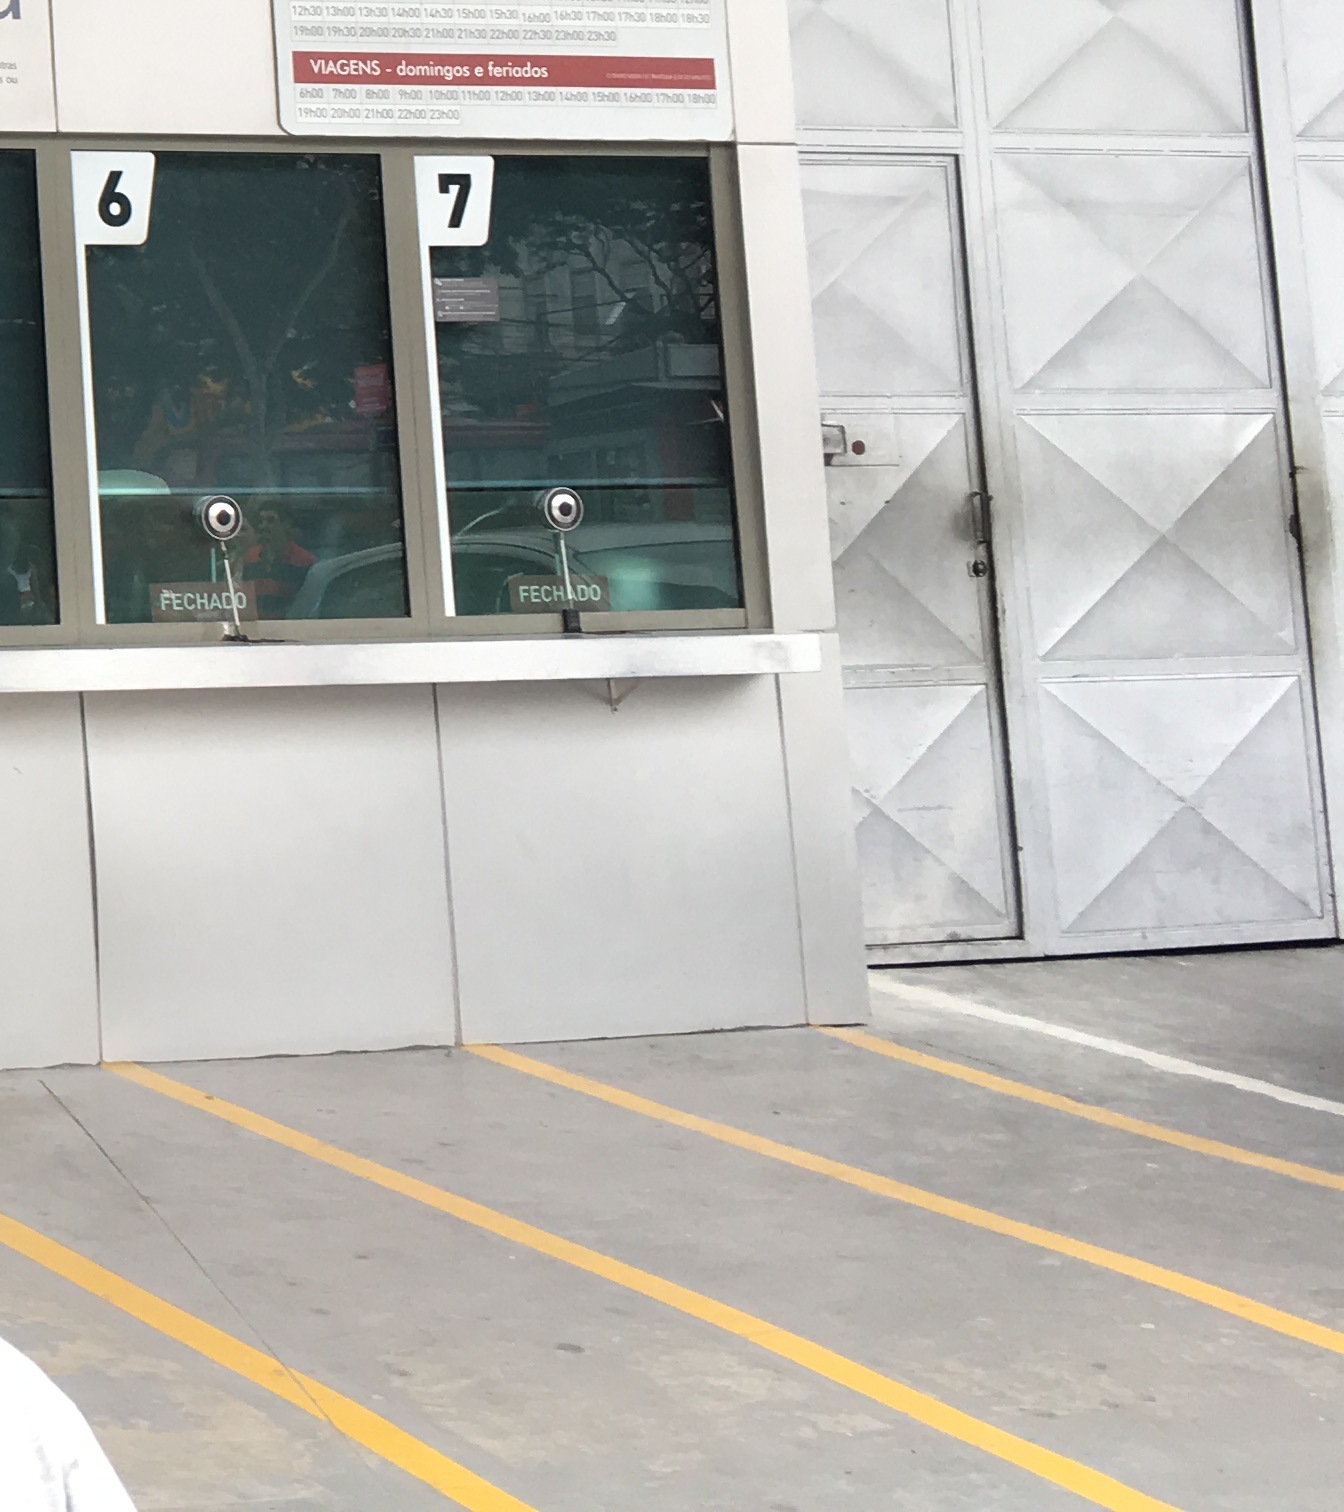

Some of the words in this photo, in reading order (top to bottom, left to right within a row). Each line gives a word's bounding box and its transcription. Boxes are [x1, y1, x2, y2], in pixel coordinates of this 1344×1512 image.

[309, 58, 381, 76] VIAGENS
[396, 59, 471, 81] domingos
[474, 65, 484, 78] e
[487, 60, 549, 78] feriados
[98, 170, 132, 227] 6
[438, 174, 472, 228] 7
[160, 590, 247, 611] FECHADO
[518, 584, 601, 604] FECHADO
